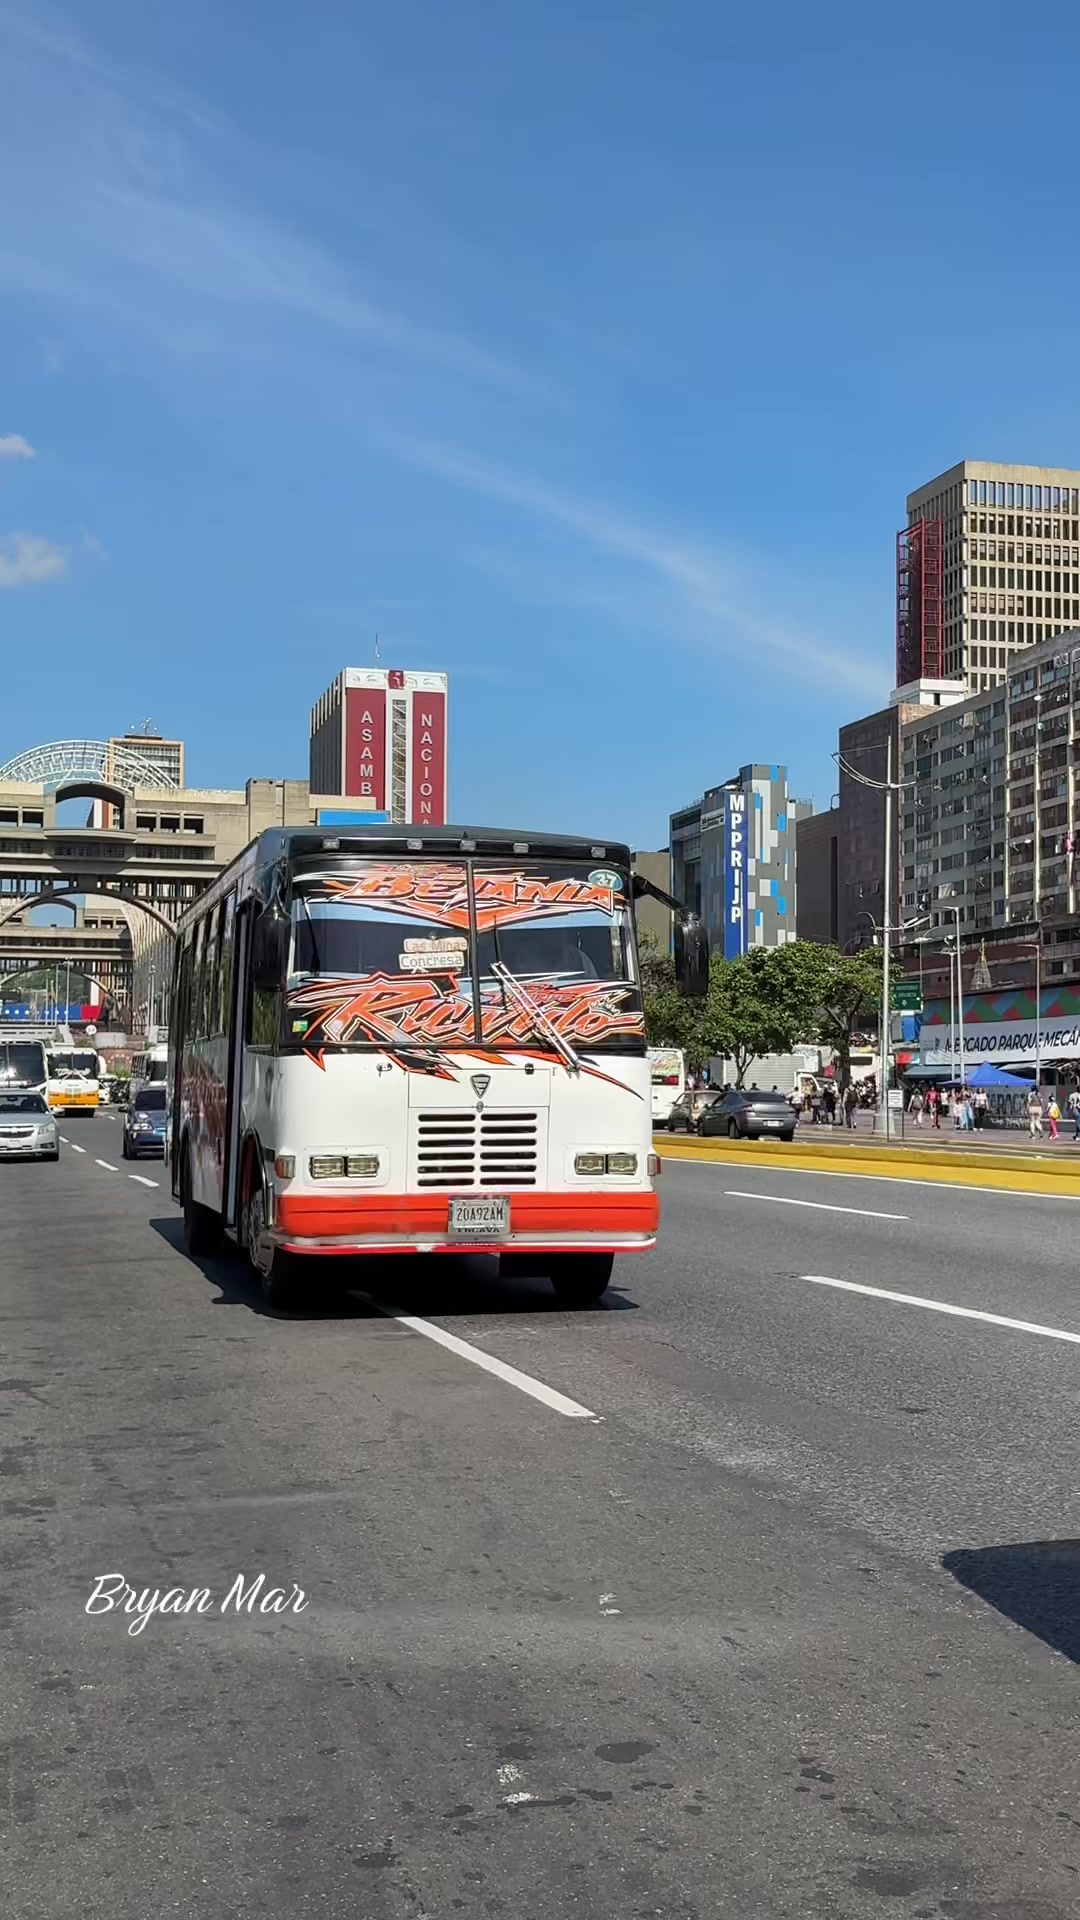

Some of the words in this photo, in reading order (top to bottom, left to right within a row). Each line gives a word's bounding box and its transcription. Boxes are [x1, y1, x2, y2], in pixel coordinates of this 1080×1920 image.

[360, 710, 374, 795] ASAMB
[729, 794, 745, 924] MPPRIJP
[405, 940, 426, 952] Las
[431, 940, 467, 951] Minas
[400, 955, 463, 968] Concresa
[997, 1032, 1044, 1052] PARQUE
